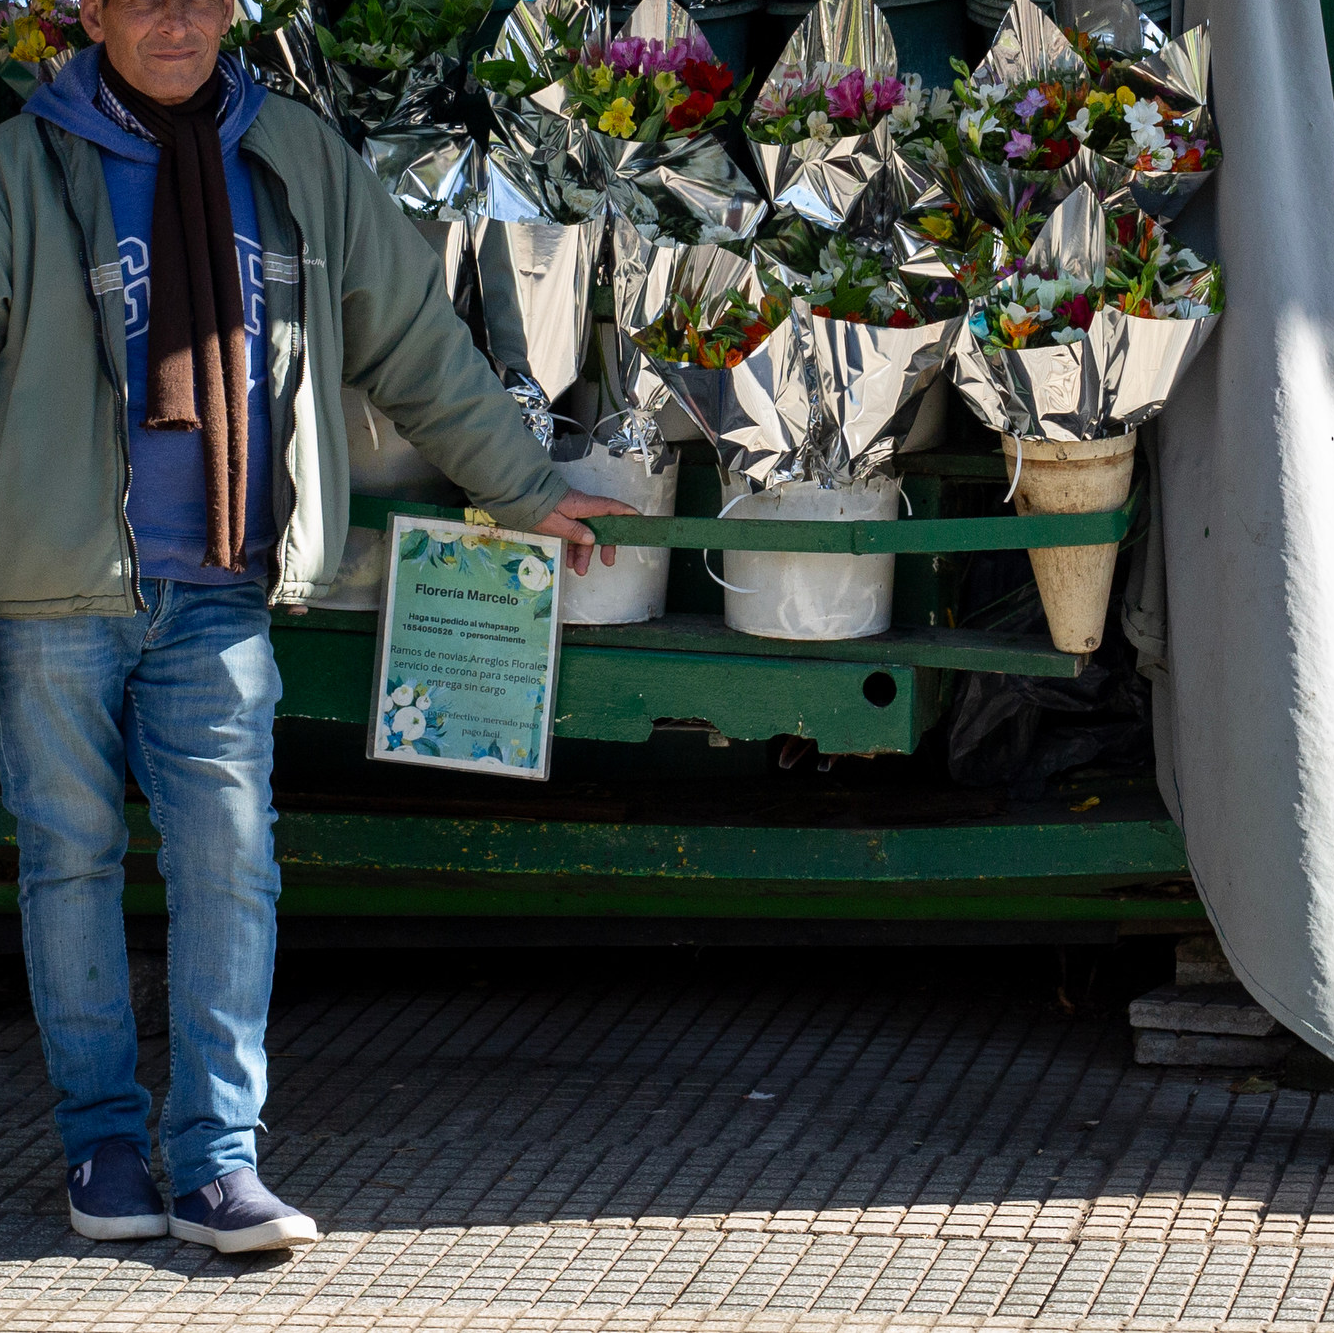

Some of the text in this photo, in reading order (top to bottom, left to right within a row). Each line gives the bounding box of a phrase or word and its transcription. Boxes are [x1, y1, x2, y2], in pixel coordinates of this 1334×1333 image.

[416, 584, 518, 605] Florería Marcelo
[409, 613, 429, 622] Haga
[441, 617, 468, 627] pedido
[466, 632, 526, 644] personalmente
[391, 645, 422, 656] Ramos
[424, 649, 436, 658] de
[394, 660, 428, 671] servicio
[431, 664, 443, 673] de
[445, 667, 477, 677] corona
[480, 671, 501, 681] para
[427, 678, 506, 696] entrega sin cargo
[449, 712, 479, 722] efectivo
